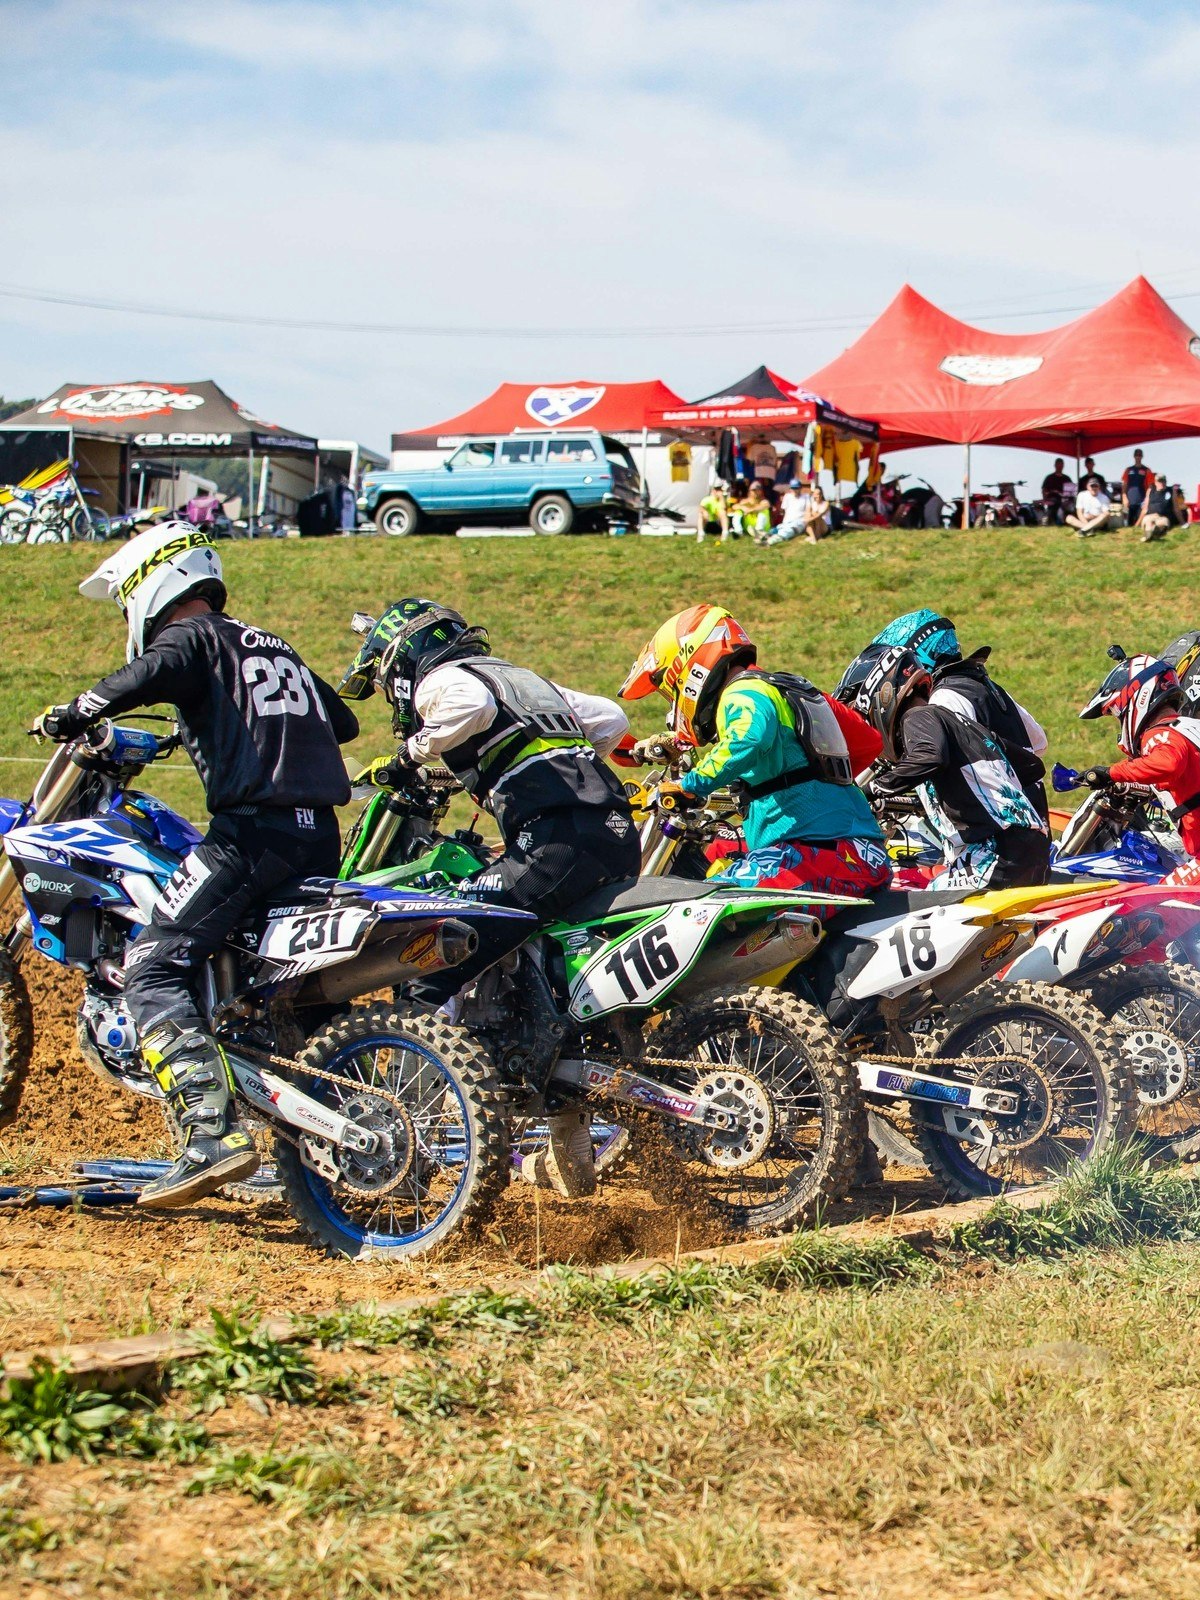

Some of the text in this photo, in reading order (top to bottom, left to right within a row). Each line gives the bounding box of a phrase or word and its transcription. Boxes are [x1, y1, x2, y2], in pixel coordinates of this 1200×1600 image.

[242, 656, 327, 722] 231
[1140, 689, 1149, 706] BELL
[295, 807, 316, 825] FLY
[169, 876, 198, 910] RACING
[403, 900, 470, 911] DUNLOP
[267, 906, 305, 918] CRUTE
[288, 910, 345, 956] 231
[888, 922, 938, 978] 18
[604, 924, 680, 1003] 116
